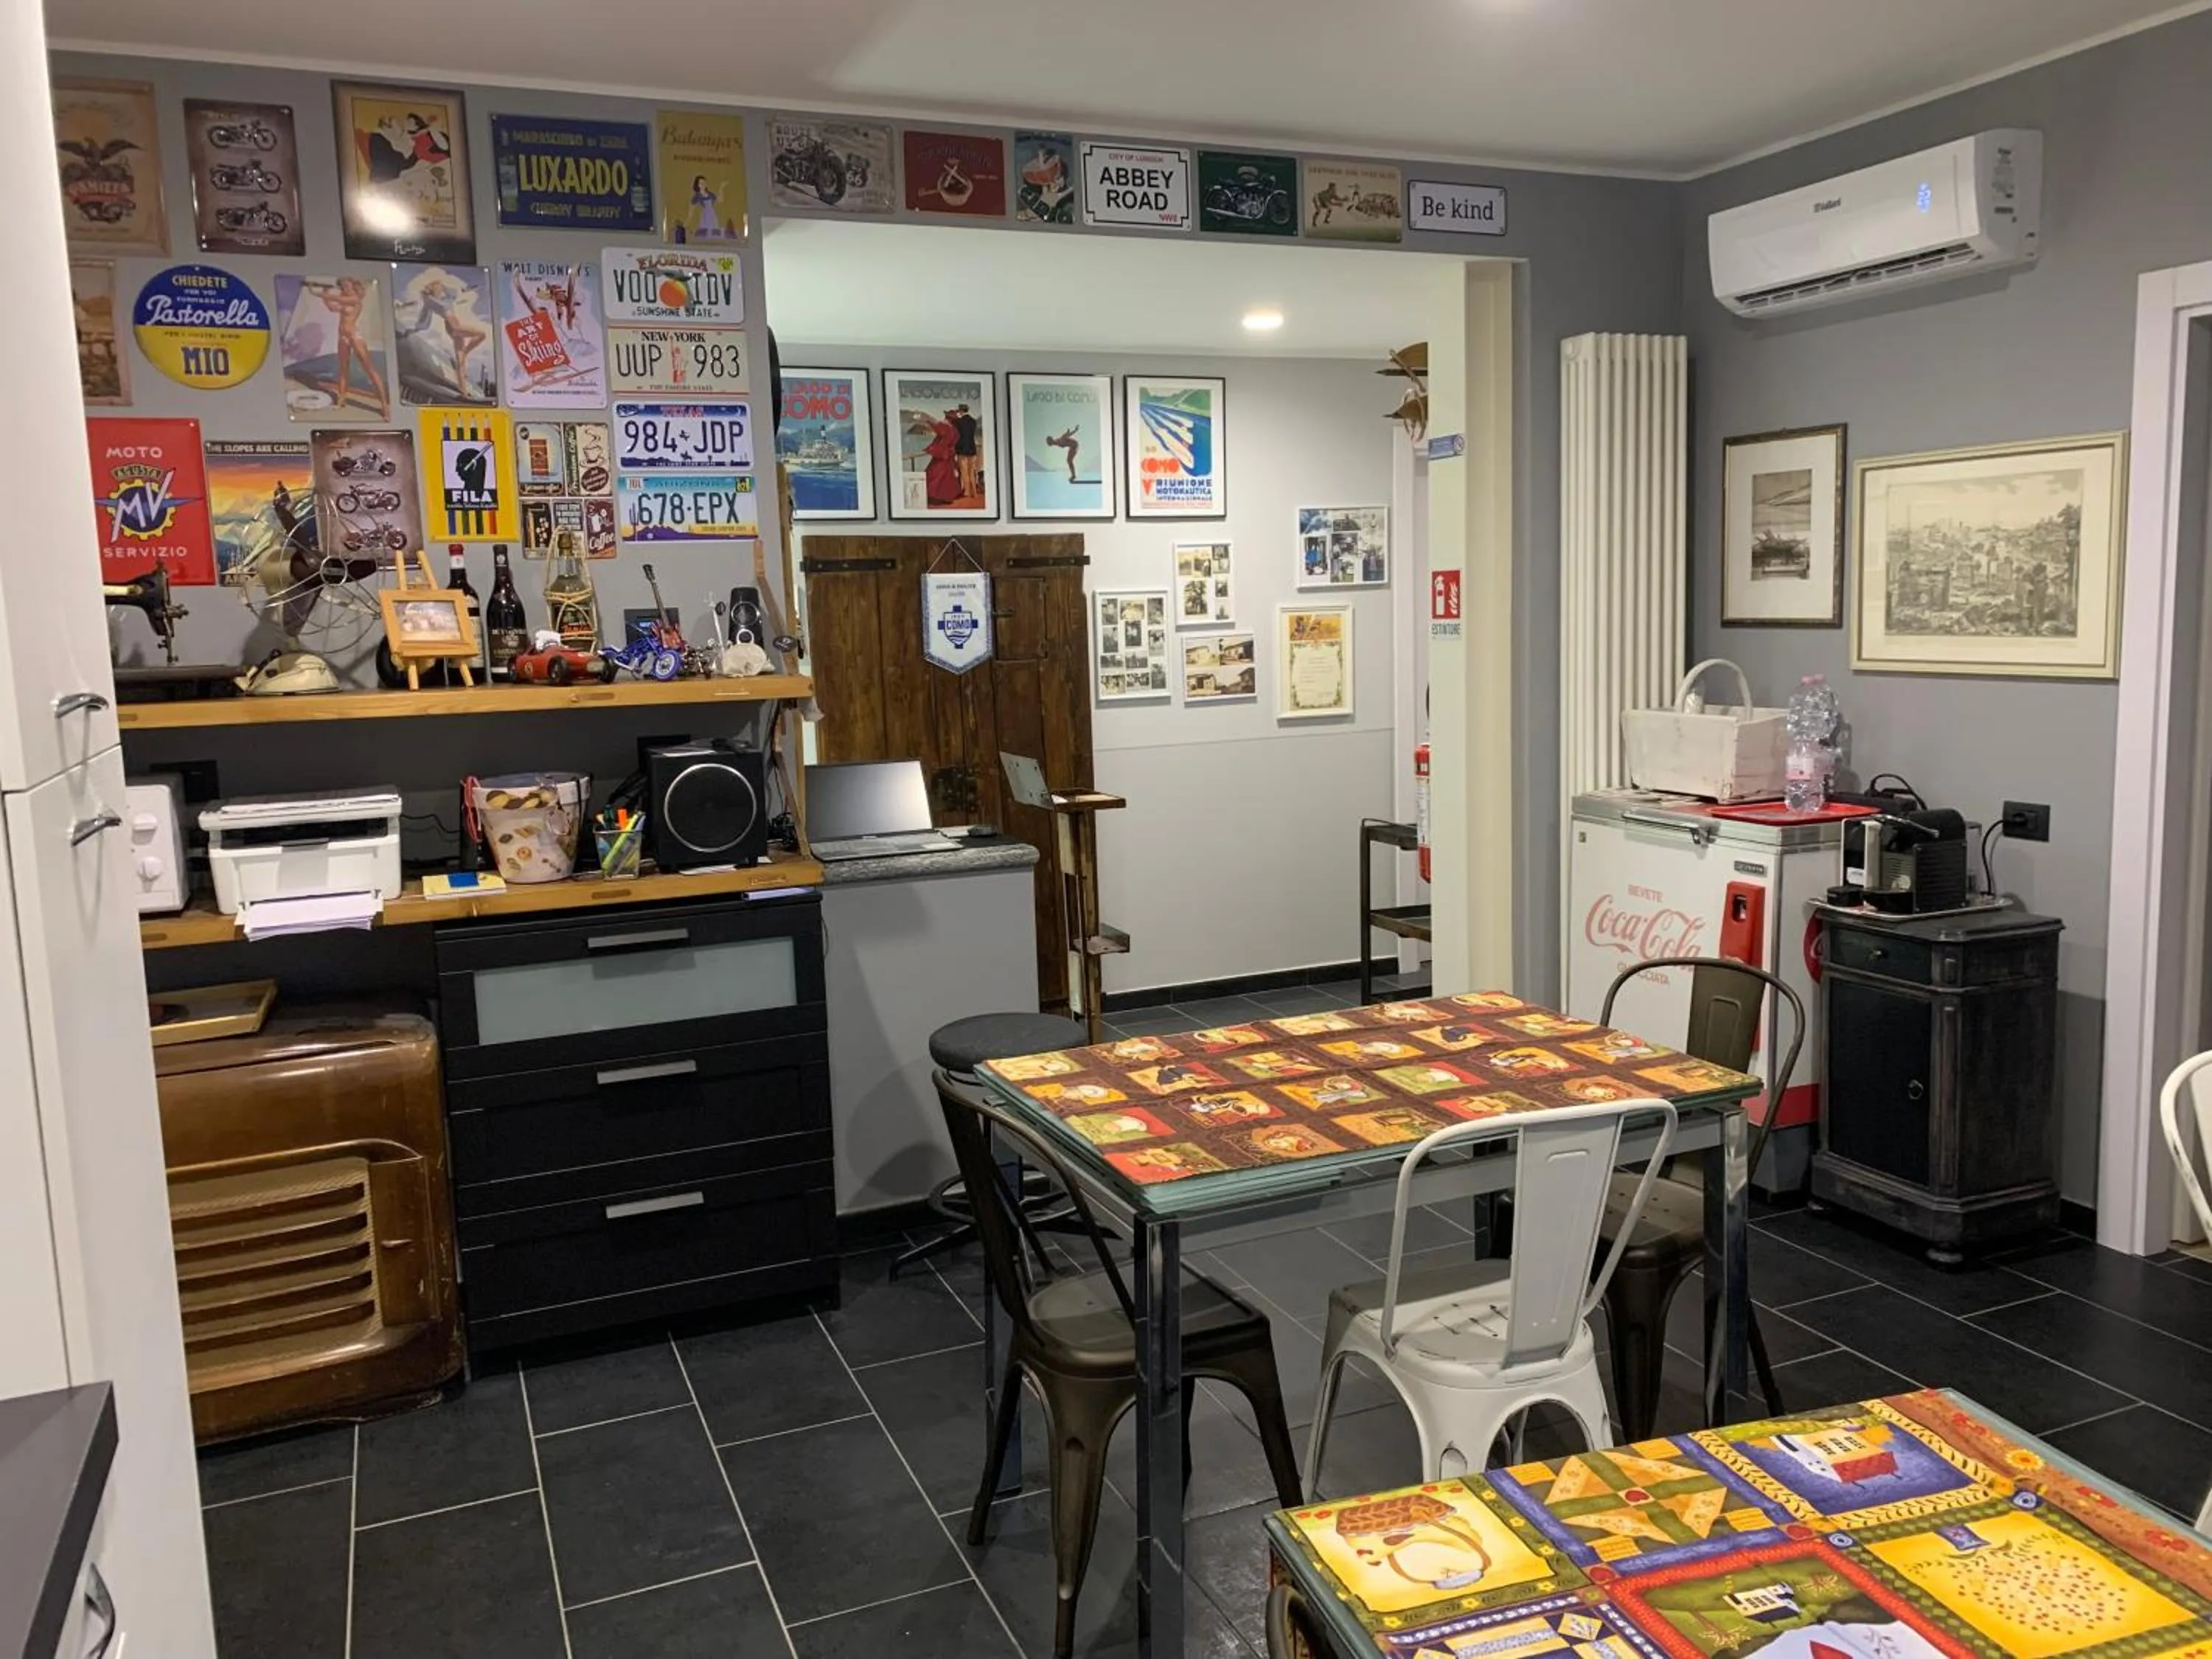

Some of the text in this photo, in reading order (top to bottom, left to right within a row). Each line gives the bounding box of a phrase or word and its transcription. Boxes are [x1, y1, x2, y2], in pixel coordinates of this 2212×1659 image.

[518, 153, 628, 197] LUXARDO
[1099, 166, 1174, 189] ABBEY
[1106, 189, 1169, 211] ROAD
[1422, 195, 1494, 220] Be kind
[637, 253, 708, 272] FLORIDA
[172, 275, 229, 289] CHIEDETE
[145, 294, 260, 326] Pastorella
[636, 306, 713, 318] SUNSHINE STATE
[518, 322, 543, 338] ART
[641, 331, 706, 343] NEW YORK
[181, 347, 230, 376] MIO
[518, 339, 565, 367] Skiing
[616, 344, 740, 378] UUP 983
[625, 420, 743, 454] 984 JDP
[105, 445, 164, 459] MOTO
[1155, 479, 1212, 487] RIUNIONE
[111, 468, 175, 543] MV
[451, 490, 493, 503] FILA
[102, 546, 187, 559] SERVIZIO
[1628, 884, 1664, 903] BEVETE
